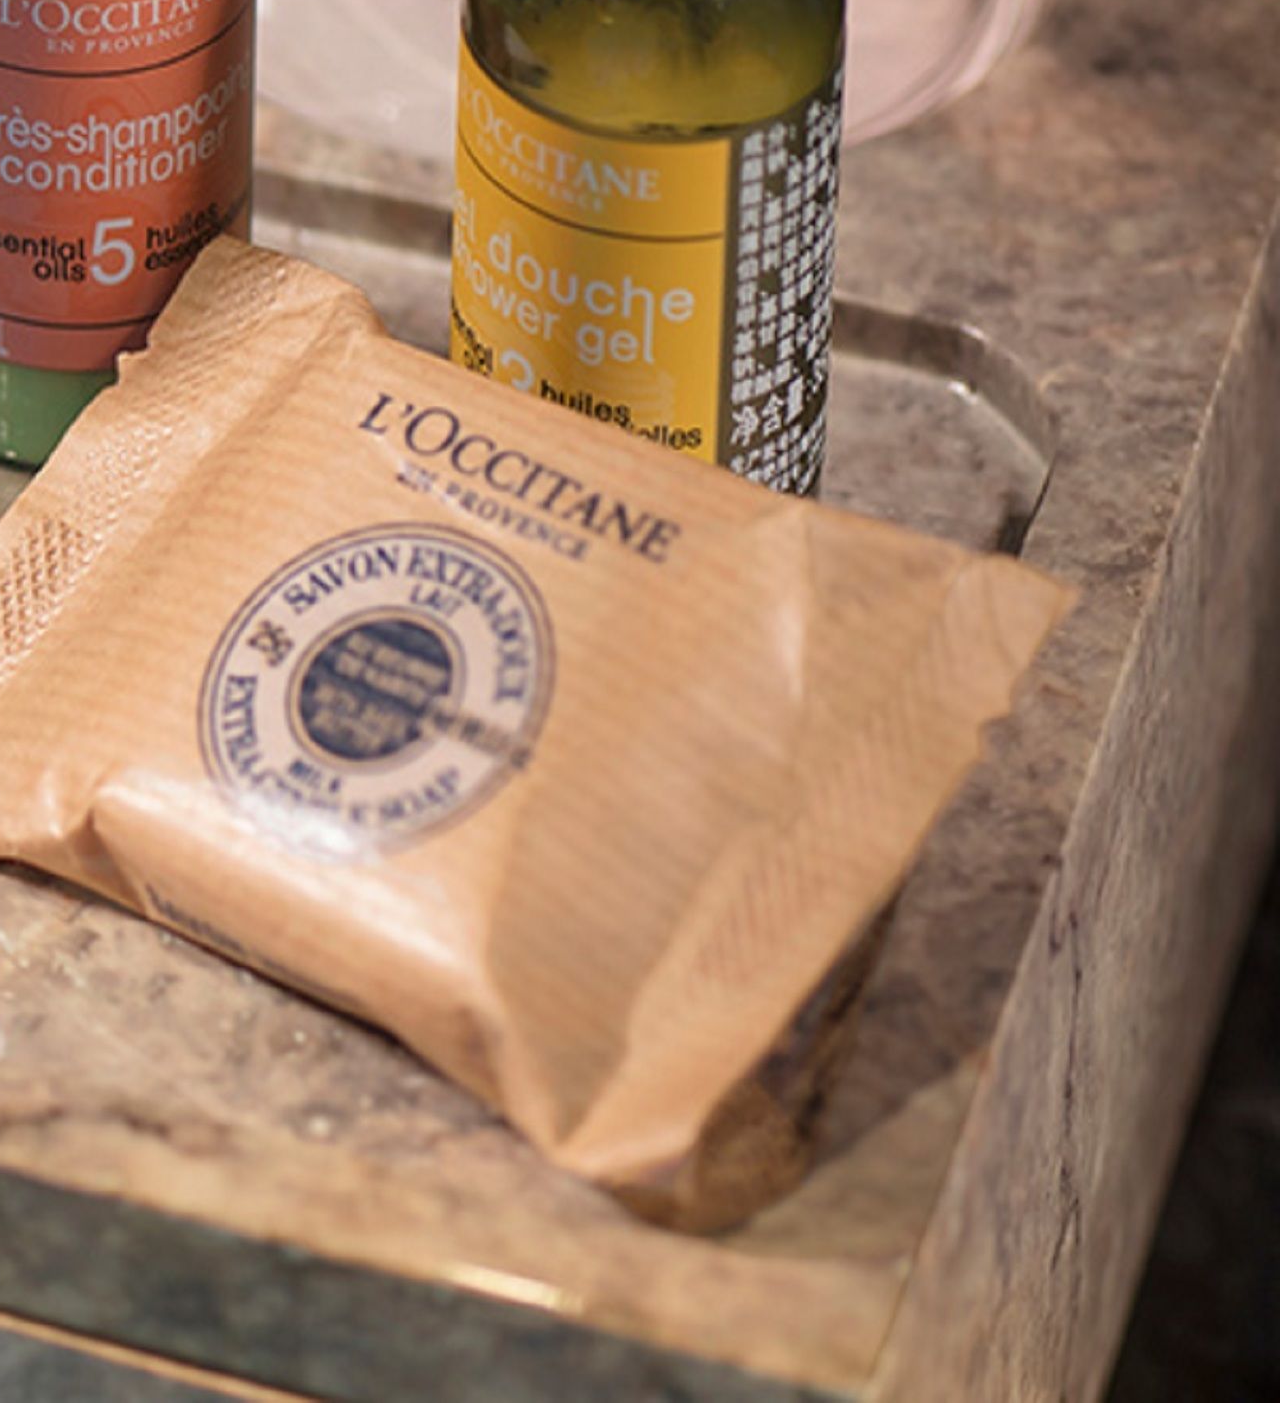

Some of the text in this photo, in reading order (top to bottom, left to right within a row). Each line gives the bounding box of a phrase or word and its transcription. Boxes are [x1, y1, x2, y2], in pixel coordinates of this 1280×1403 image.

[45, 19, 196, 55] EN PROVENCE
[33, 251, 87, 285] oils
[90, 217, 137, 287] 5
[487, 231, 695, 323] douche
[575, 300, 655, 367] gel
[358, 393, 682, 564] L'OCCITANE
[445, 482, 589, 563] PROVENCE
[283, 544, 400, 615] SAVON
